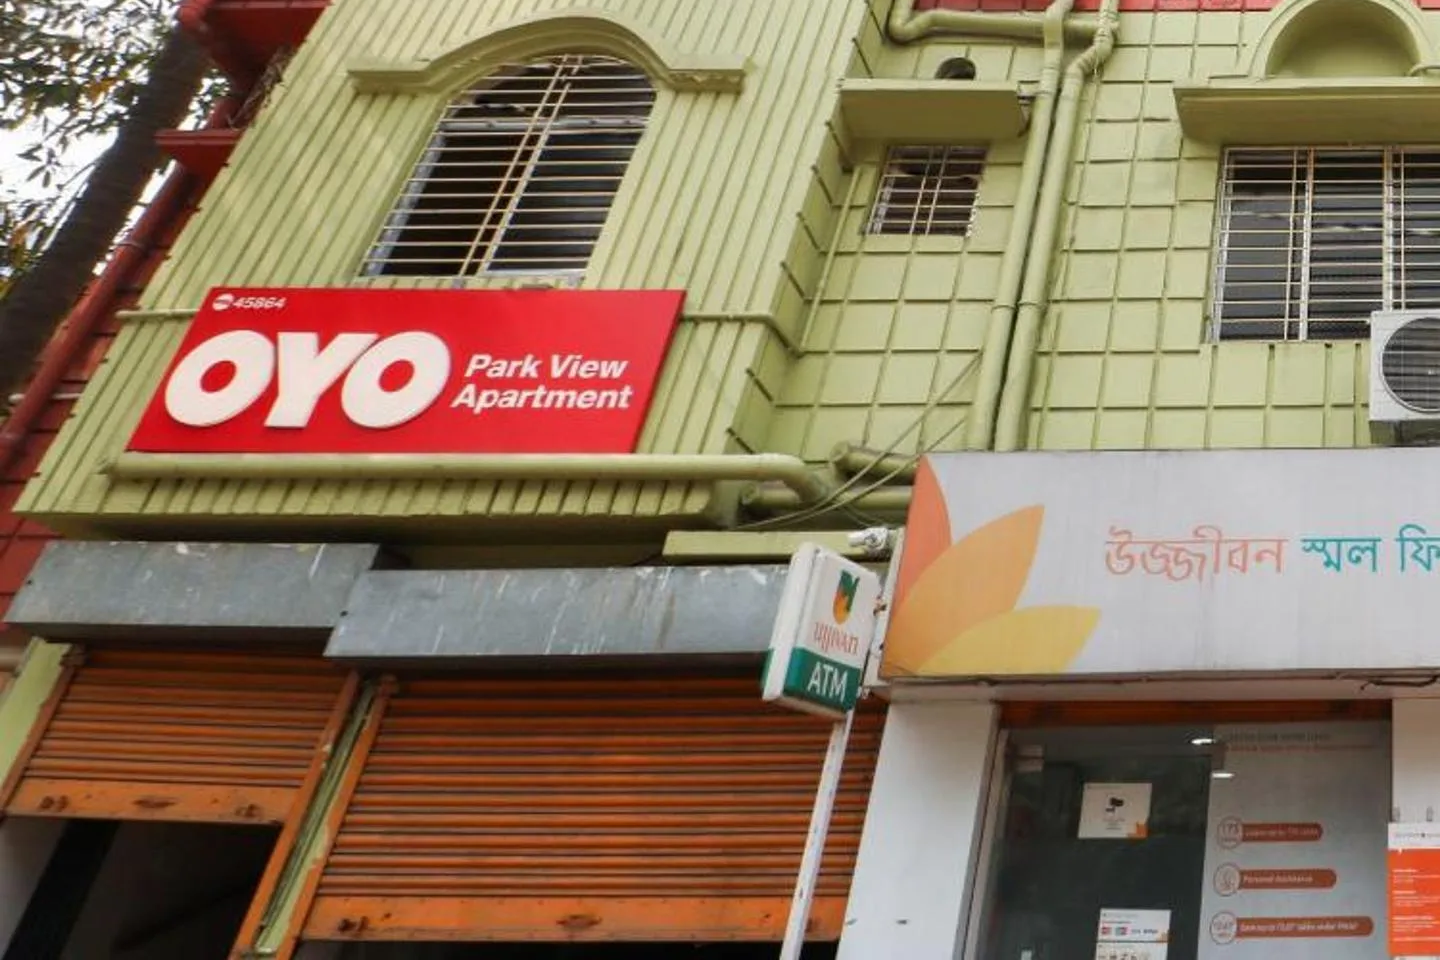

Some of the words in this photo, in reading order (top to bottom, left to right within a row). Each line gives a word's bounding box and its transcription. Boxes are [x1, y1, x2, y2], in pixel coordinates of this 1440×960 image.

[164, 329, 451, 428] OYO
[464, 354, 541, 379] Park
[548, 354, 628, 379] View
[451, 384, 633, 415] Apartment
[1105, 525, 1289, 582] উজ্জীবন
[807, 661, 849, 703] ATM
